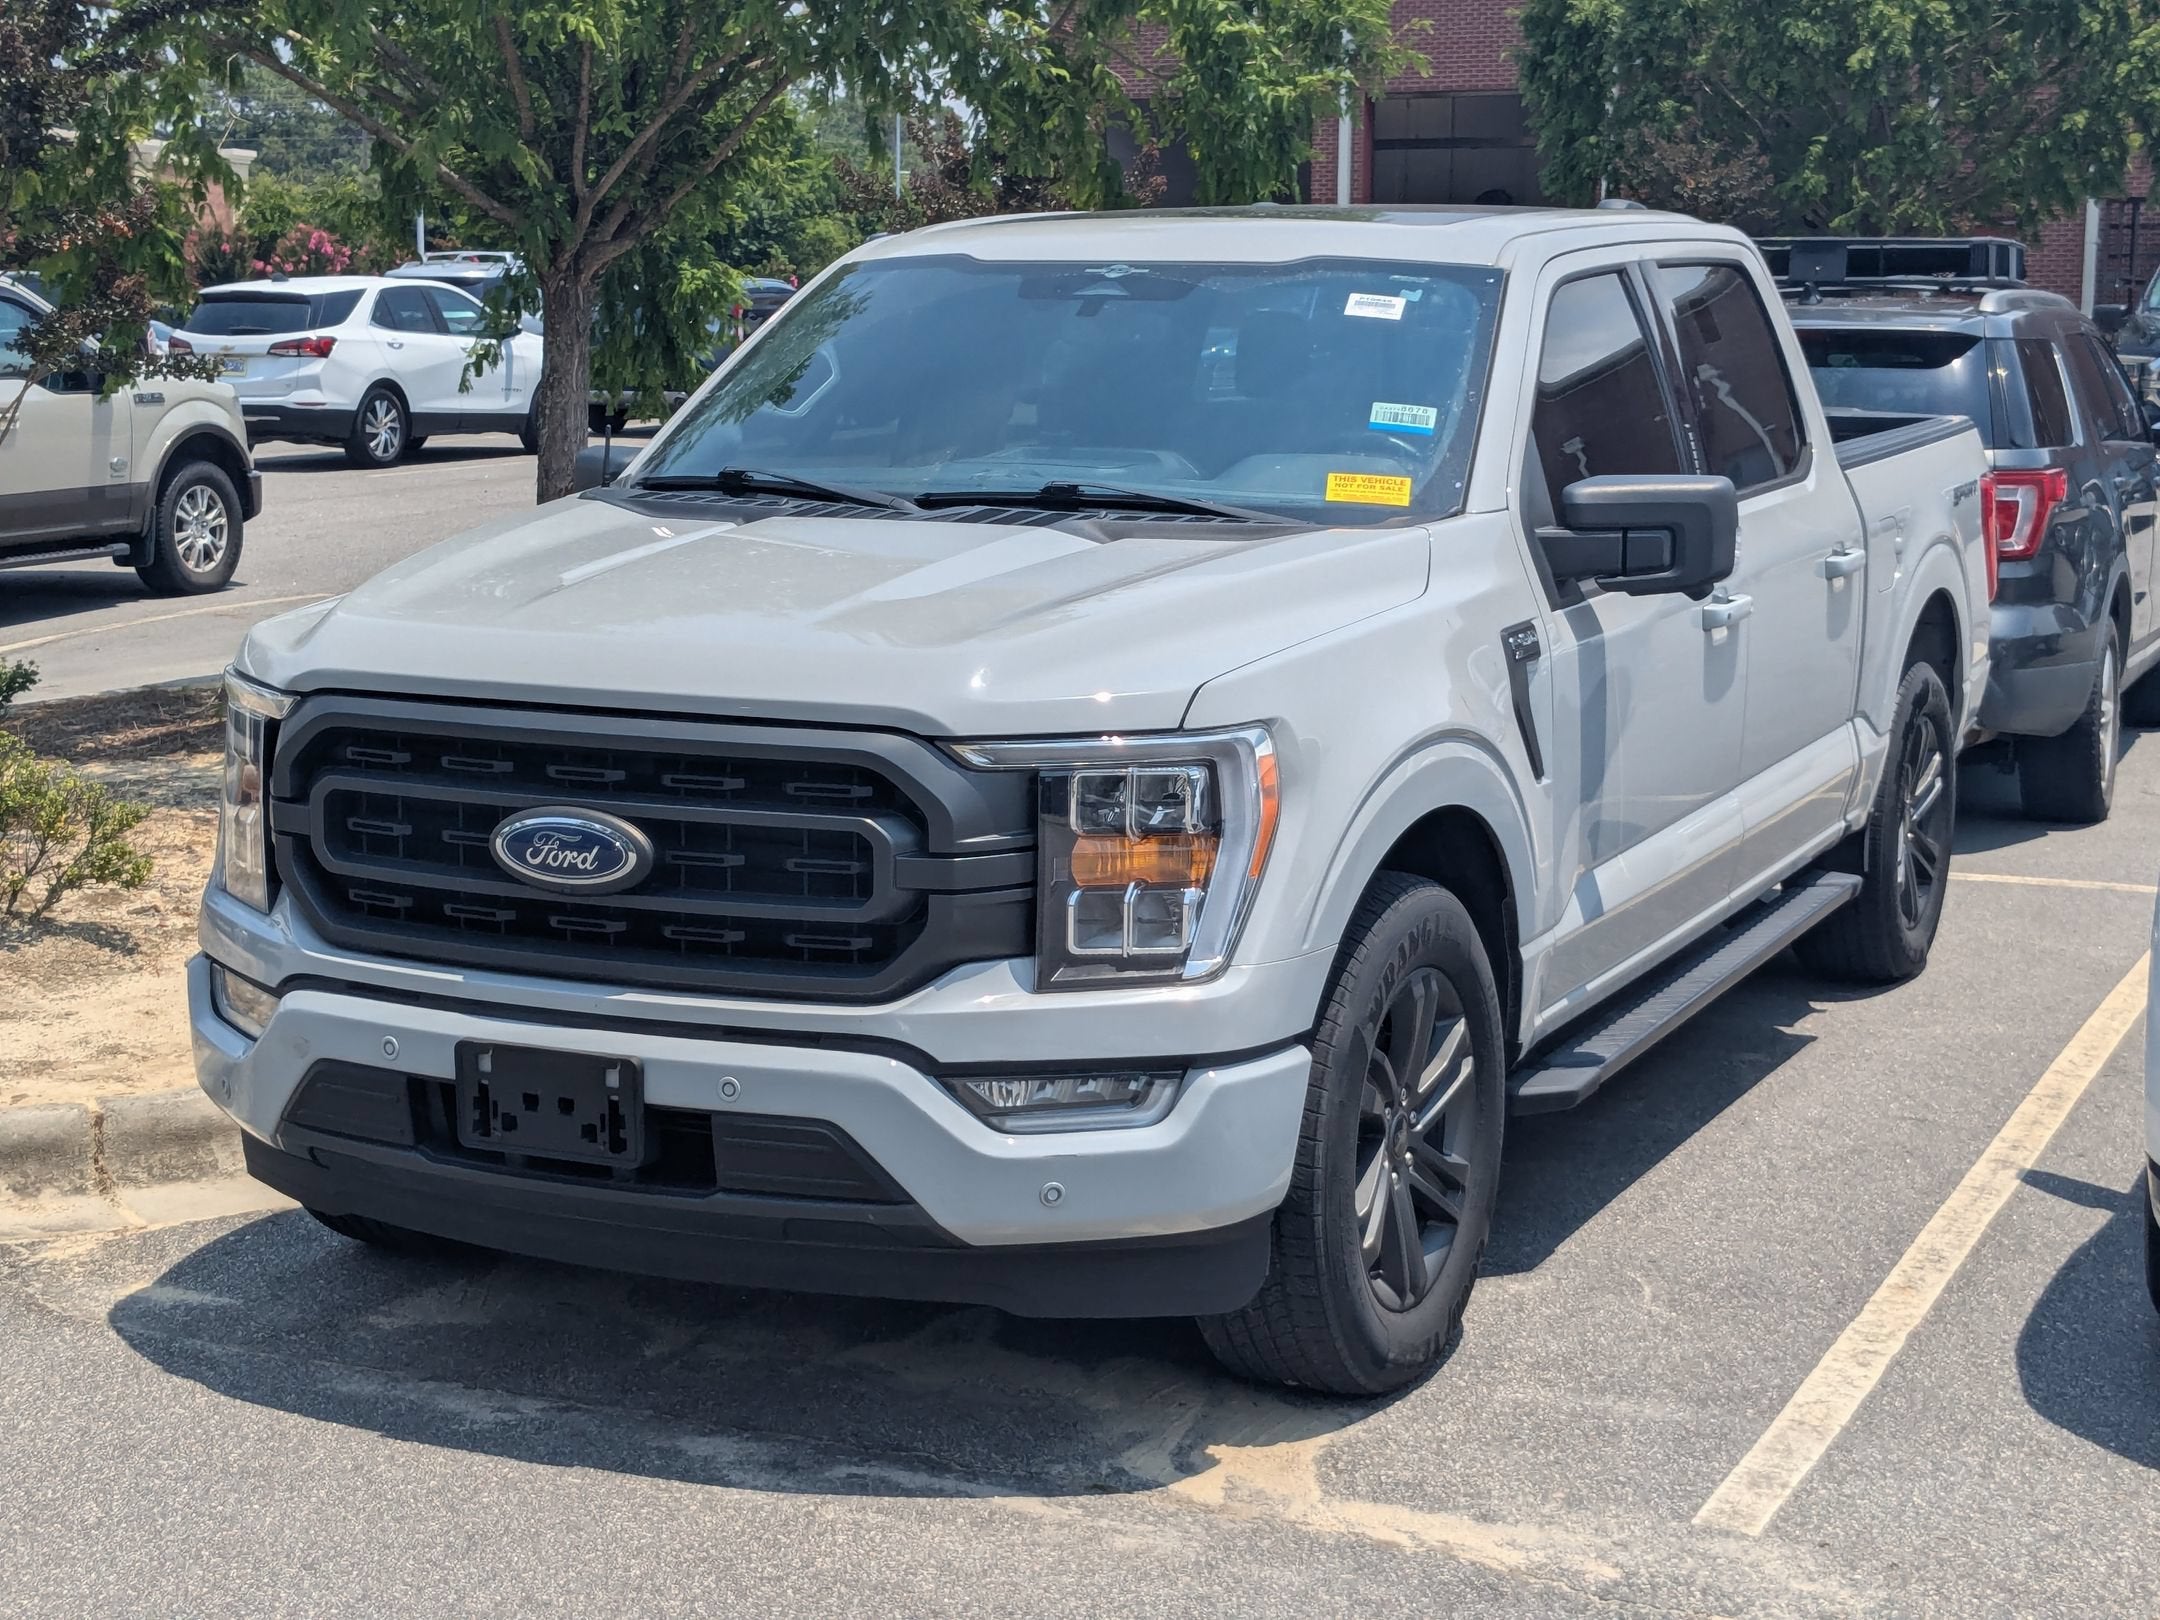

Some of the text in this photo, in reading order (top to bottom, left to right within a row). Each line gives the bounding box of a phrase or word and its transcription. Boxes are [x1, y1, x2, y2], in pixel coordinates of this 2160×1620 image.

[1333, 475, 1407, 487] THIS VEHICLE
[1380, 485, 1405, 493] SALE
[526, 831, 600, 870] Ford
[1367, 911, 1462, 1030] WRANGLE
